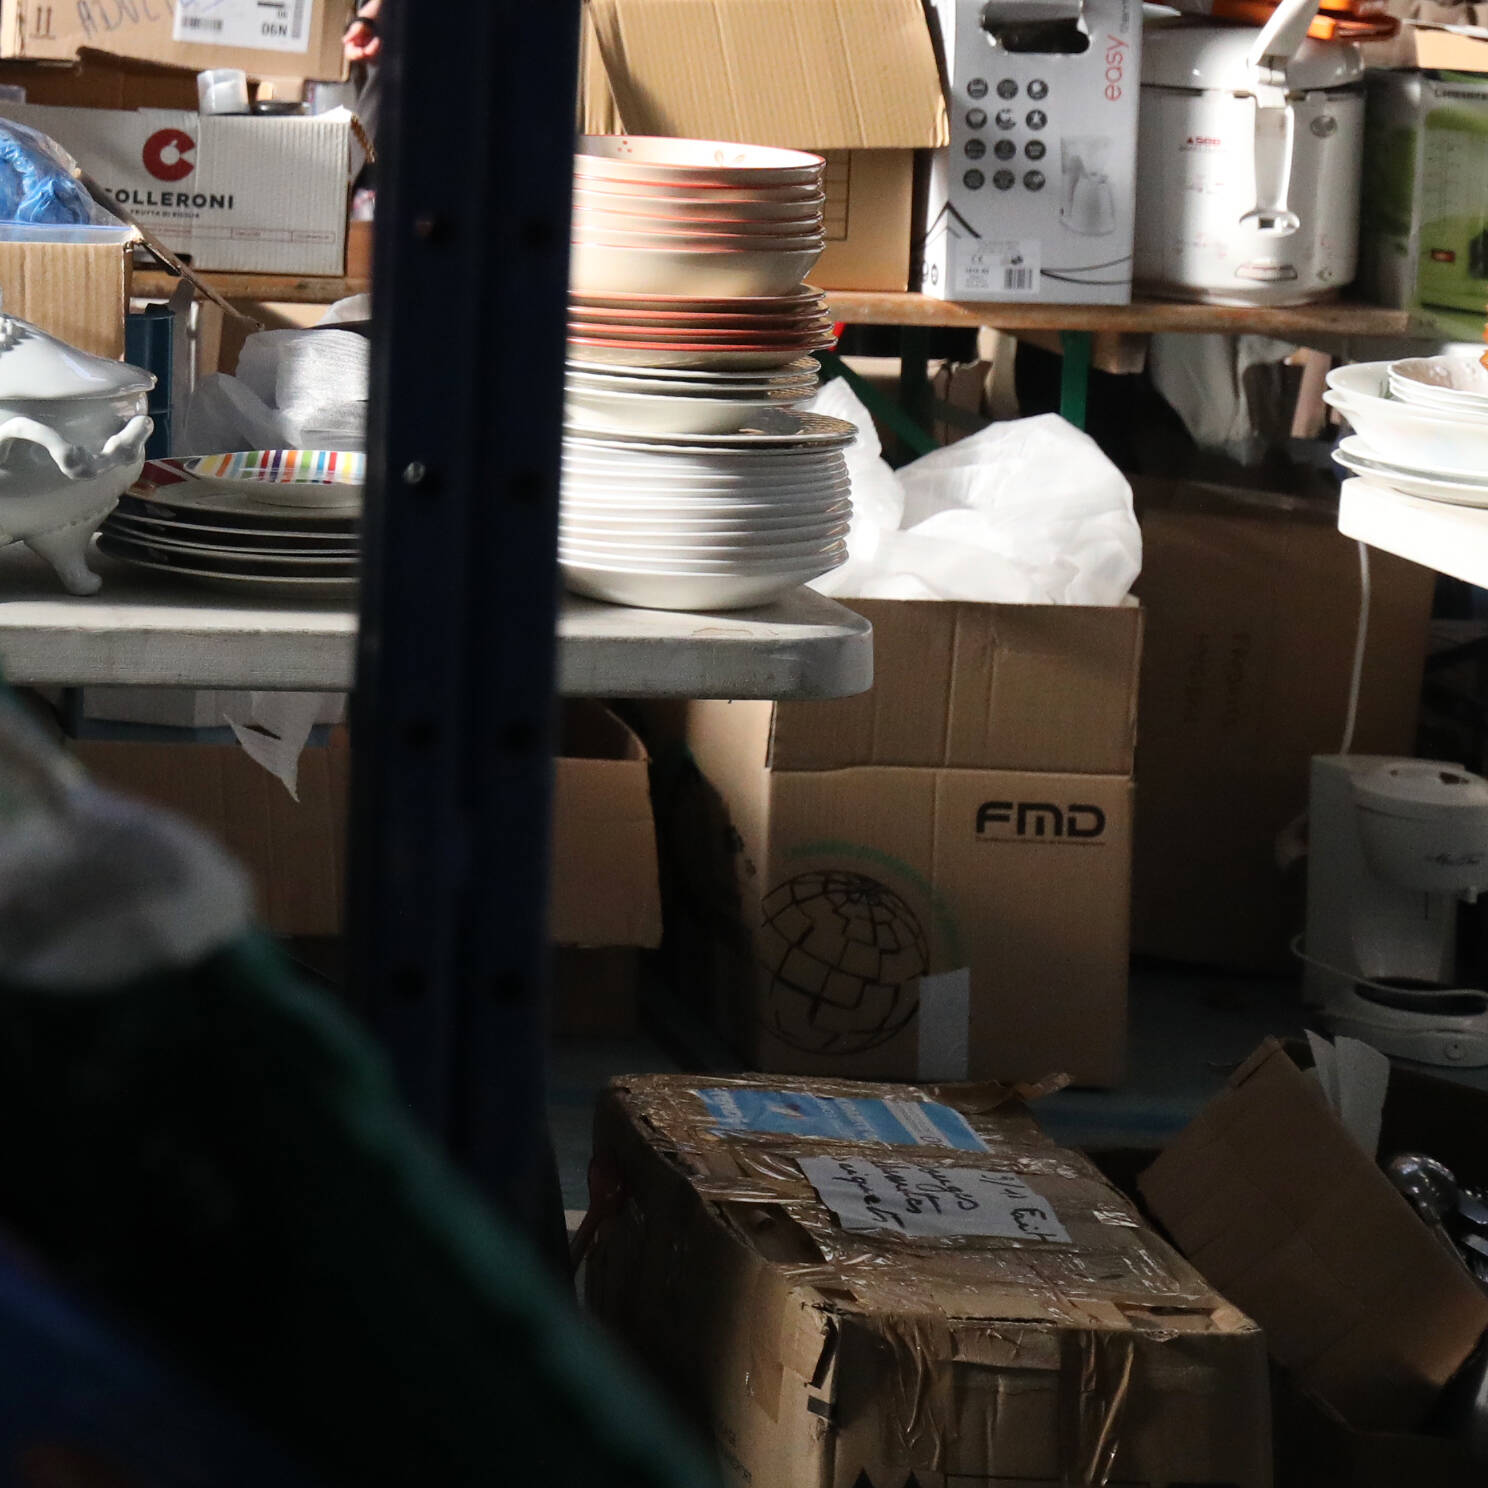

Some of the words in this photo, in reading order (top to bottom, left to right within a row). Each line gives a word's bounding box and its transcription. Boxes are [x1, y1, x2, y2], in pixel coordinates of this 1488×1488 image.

[1105, 34, 1129, 103] easy
[105, 187, 234, 210] OLLERONI
[976, 801, 1106, 838] FMD
